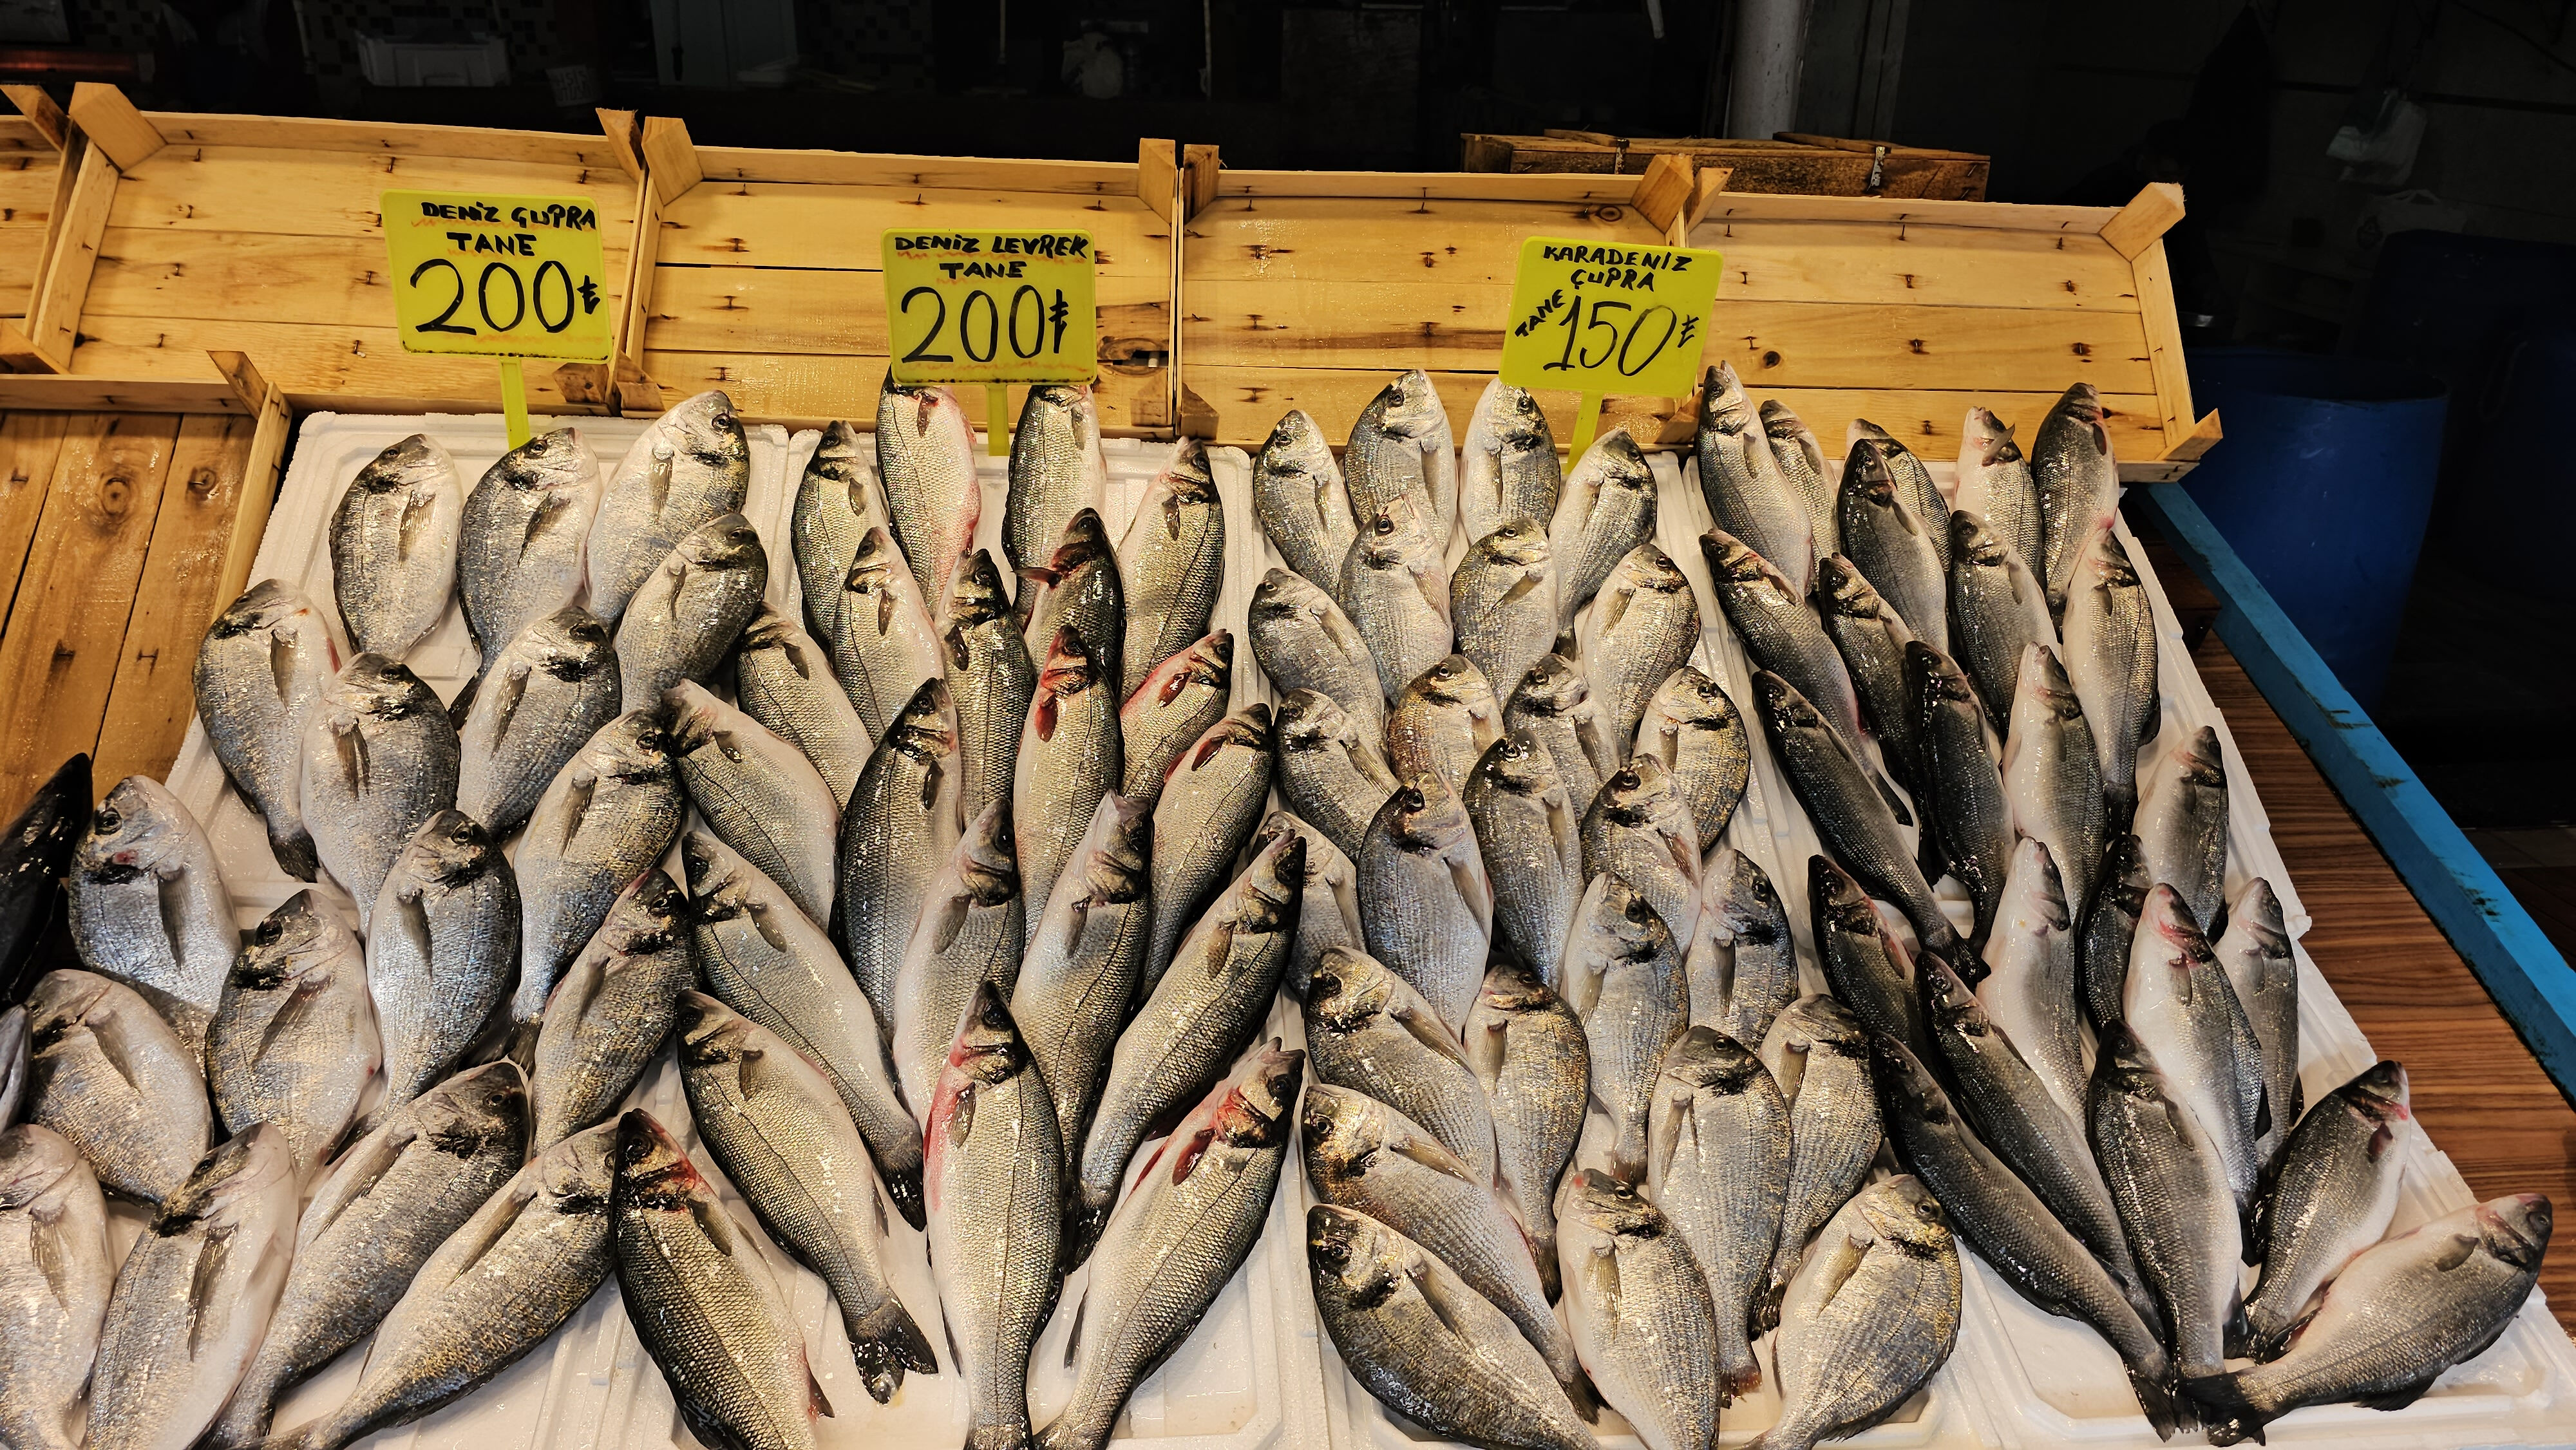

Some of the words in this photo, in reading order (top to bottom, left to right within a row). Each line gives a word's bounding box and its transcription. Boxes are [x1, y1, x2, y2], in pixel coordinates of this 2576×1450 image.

[421, 202, 501, 222] DENİZ
[446, 232, 537, 256] TANE
[895, 234, 980, 253] DENİZ
[991, 234, 1089, 259] LEVREK
[939, 261, 1027, 279] TANE
[1570, 267, 1654, 292] ÇUPRA
[1514, 289, 1567, 337] TANE
